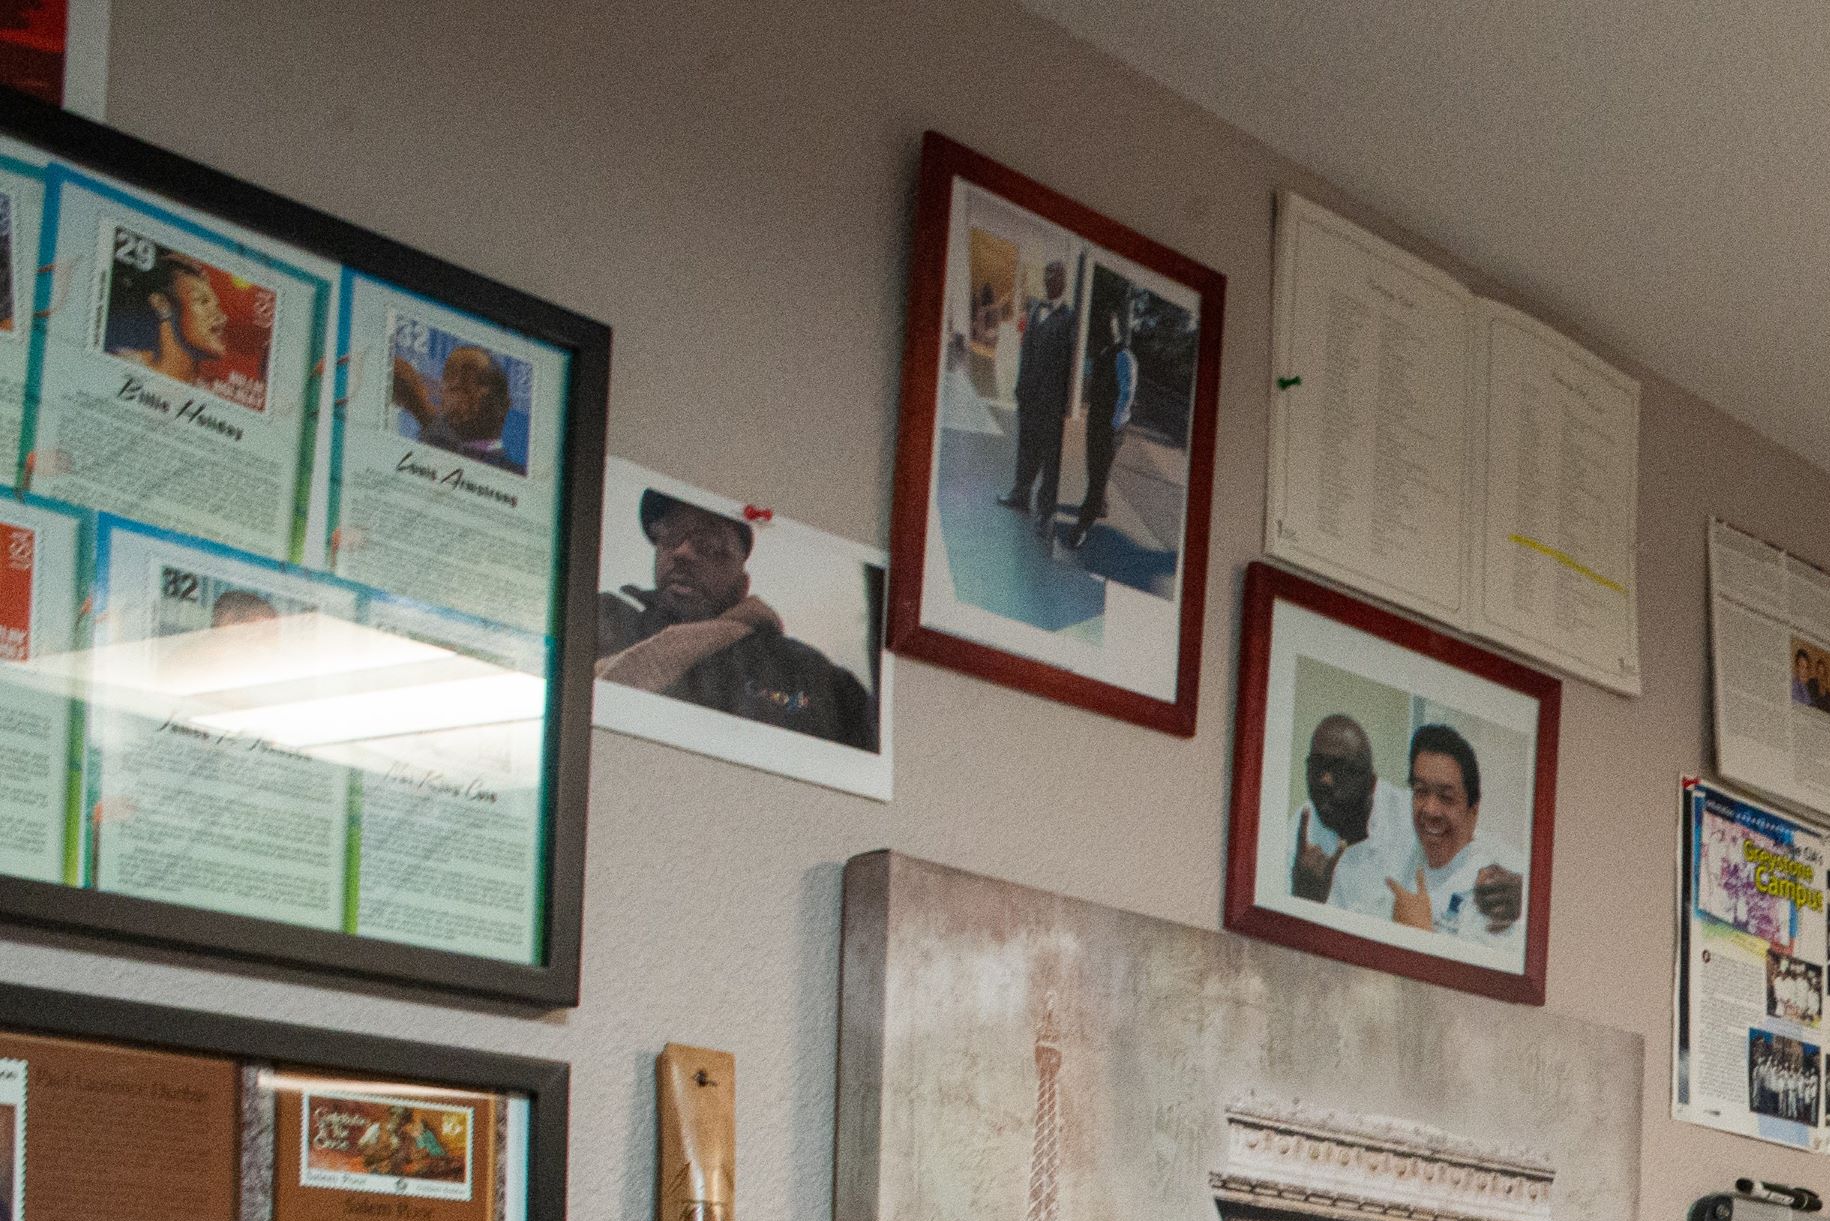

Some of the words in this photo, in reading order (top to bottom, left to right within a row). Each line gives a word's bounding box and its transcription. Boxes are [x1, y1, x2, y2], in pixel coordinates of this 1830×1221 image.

[116, 231, 156, 272] 29
[160, 566, 199, 603] 32
[1743, 838, 1813, 884] Greystone
[1754, 866, 1824, 912] Campus
